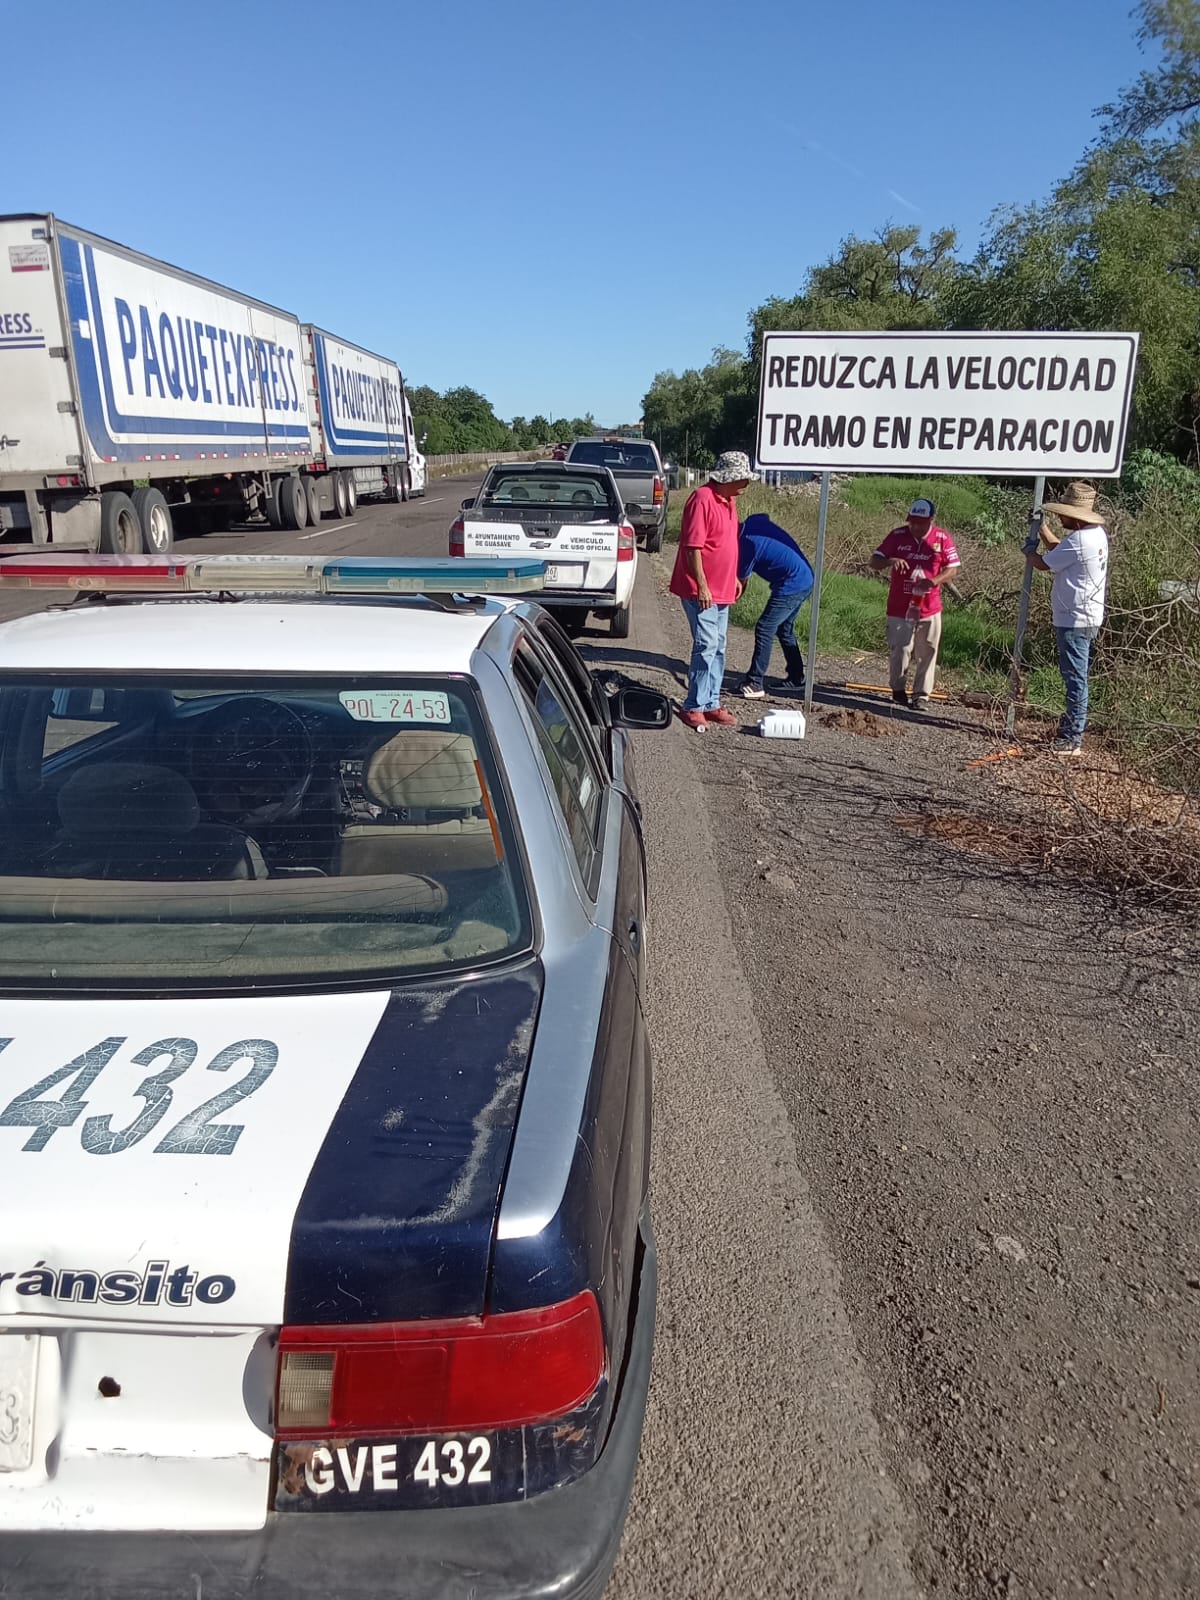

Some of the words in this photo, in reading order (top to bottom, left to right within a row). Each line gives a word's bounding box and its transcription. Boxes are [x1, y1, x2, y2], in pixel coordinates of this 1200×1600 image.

[114, 297, 298, 412] PAQUETEXPRESS
[768, 355, 896, 389] REDUZCA
[904, 356, 939, 390] LA
[946, 356, 1117, 391] VELOCIDAD
[766, 413, 866, 448] TRAMO
[873, 416, 912, 449] EN
[918, 417, 1114, 453] REPARACION
[474, 533, 521, 541] AYUNTAMIENTO
[484, 540, 512, 548] GUASAVE
[570, 537, 604, 545] VEHICULO
[586, 544, 613, 552] OFICIAL
[304, 1444, 399, 1495] GVE
[413, 1436, 492, 1488] 432
